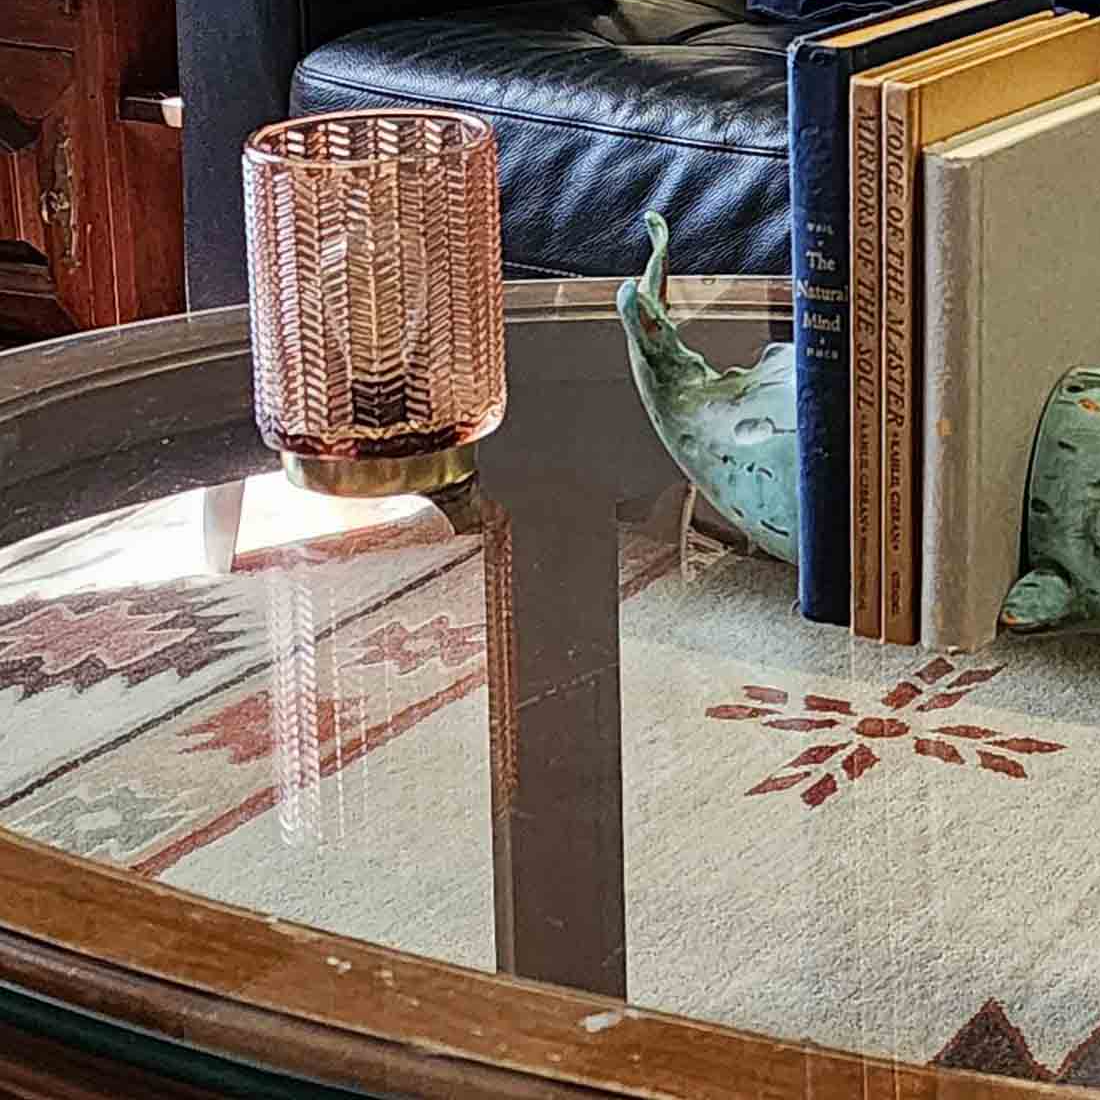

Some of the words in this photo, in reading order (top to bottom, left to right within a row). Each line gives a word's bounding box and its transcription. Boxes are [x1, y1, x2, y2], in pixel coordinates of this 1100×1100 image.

[858, 106, 876, 231] MIRRORS
[887, 113, 905, 198] VOICE
[887, 206, 905, 243] OF
[805, 250, 836, 271] The
[858, 238, 876, 273] OF
[887, 248, 905, 305] THE
[796, 277, 849, 303] Natural
[857, 276, 875, 336] THE
[802, 311, 841, 333] Mind
[857, 343, 875, 410] SOUL
[887, 311, 905, 428] MASTER
